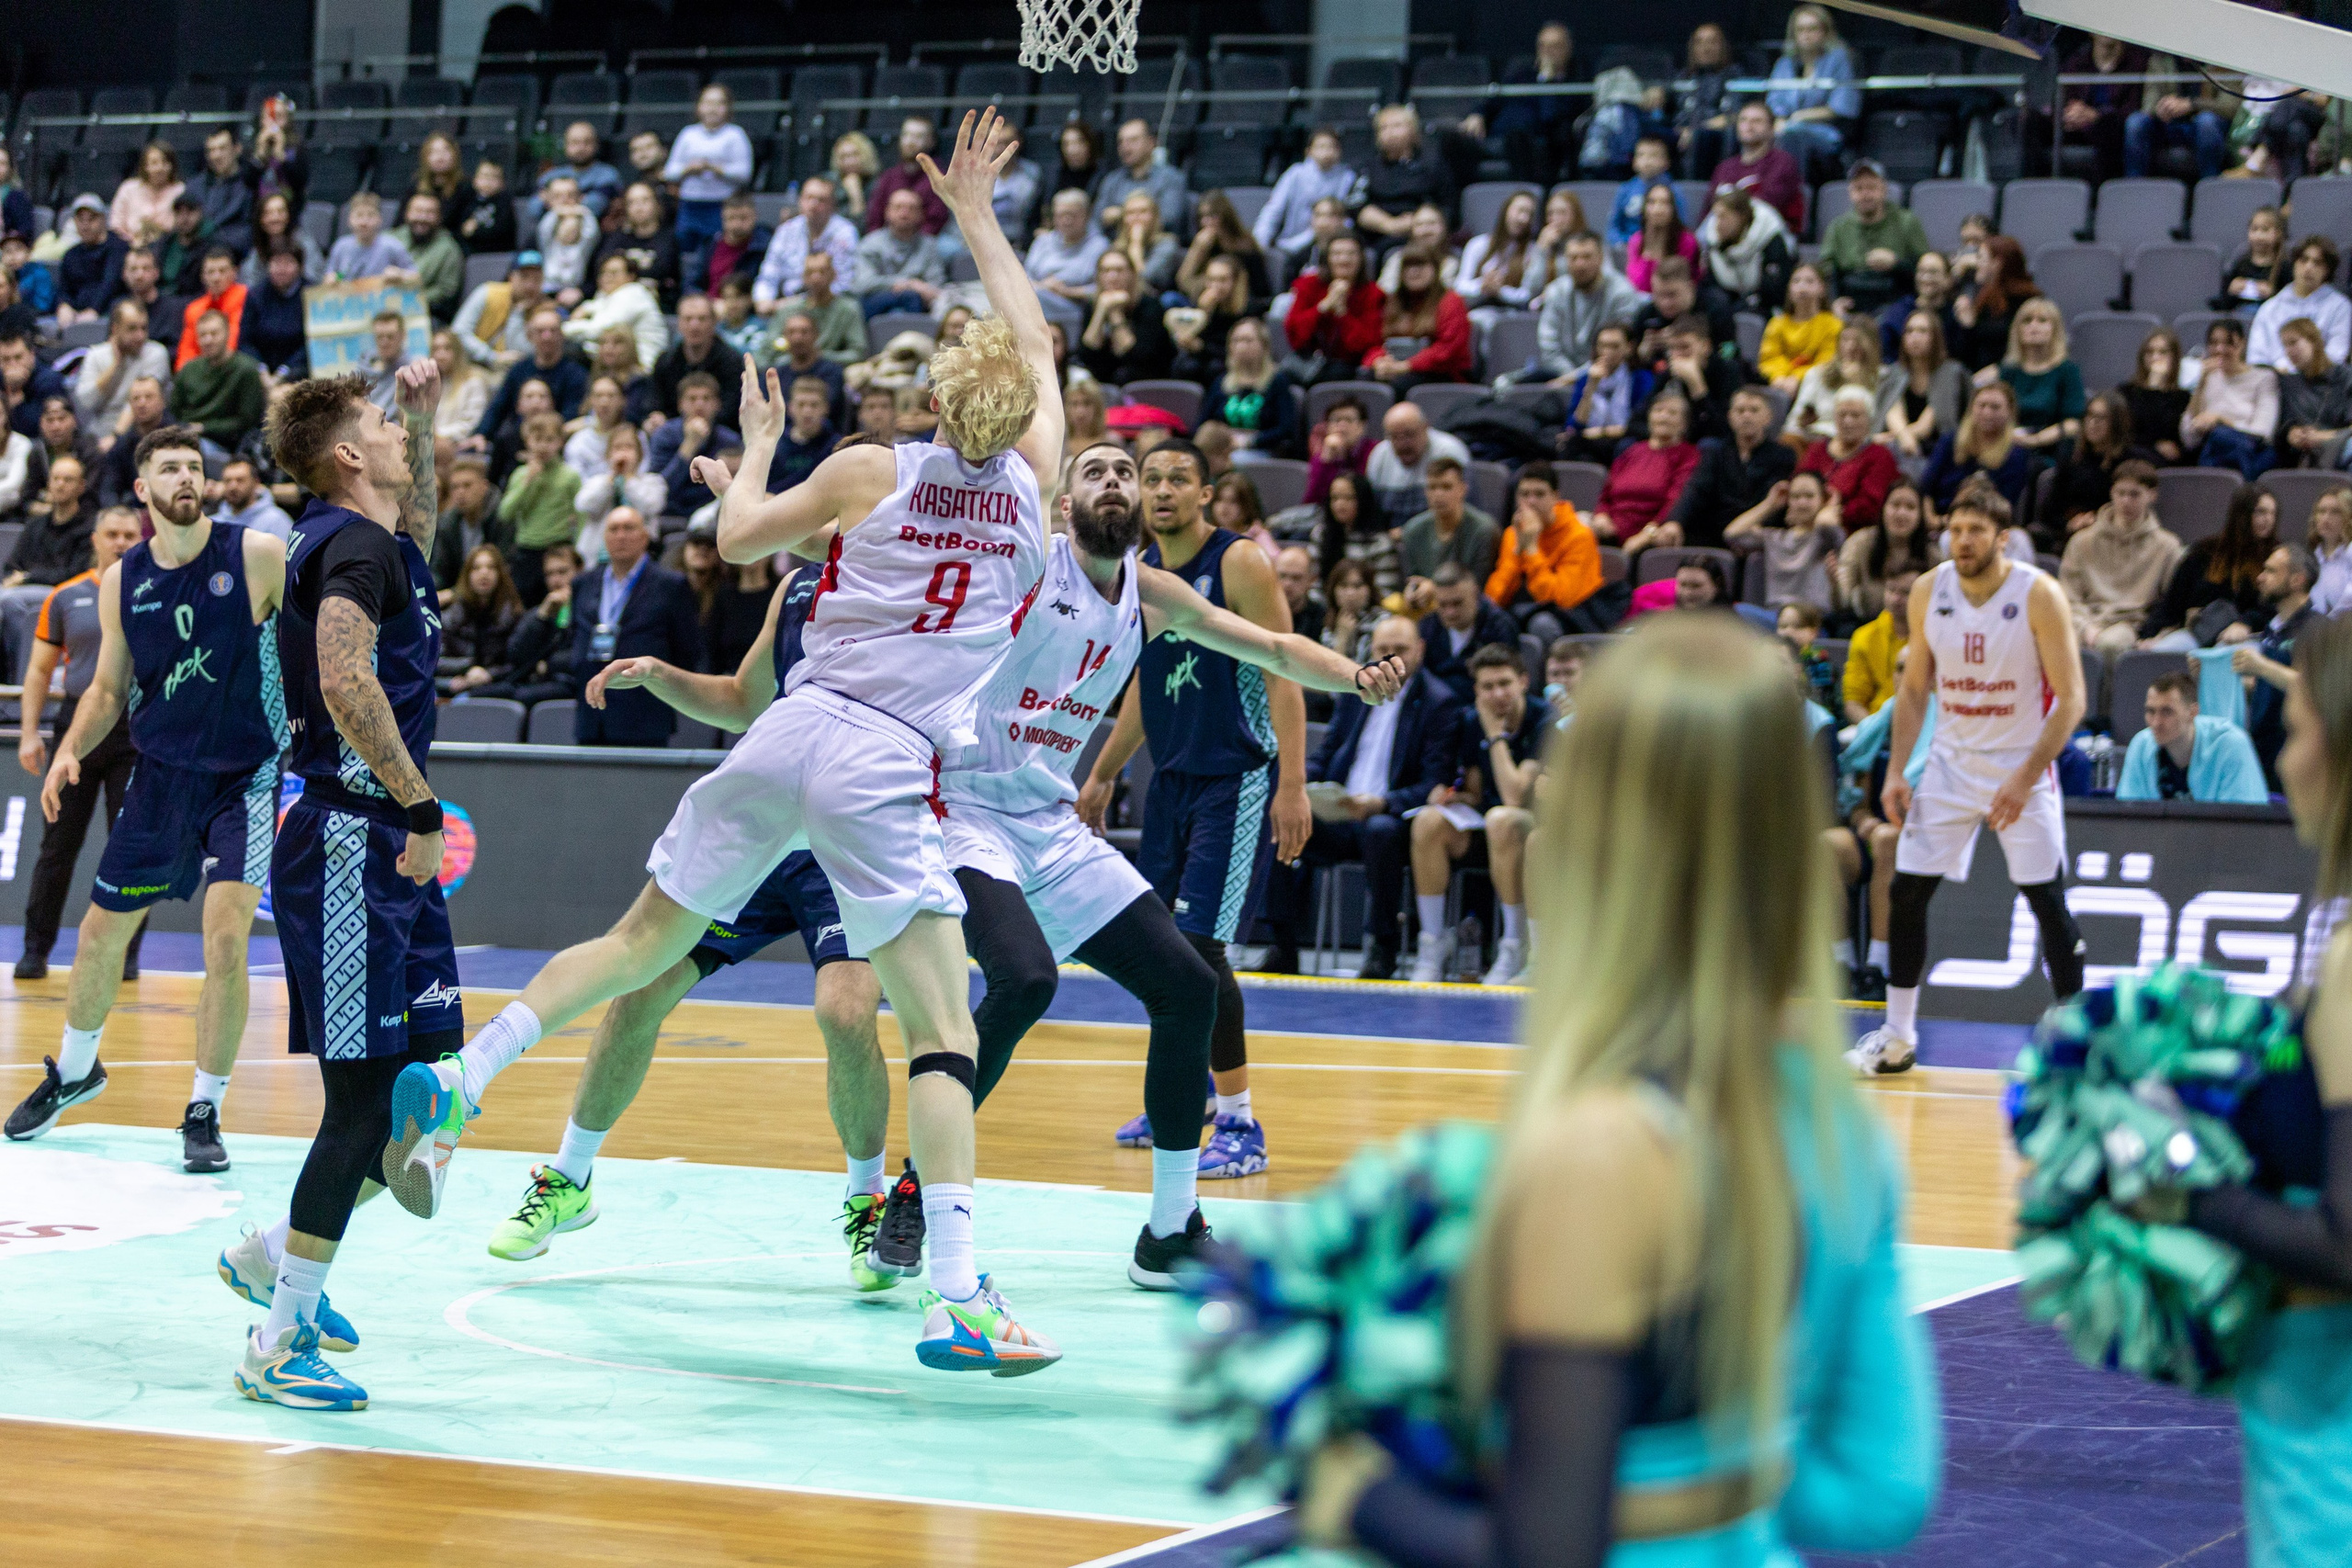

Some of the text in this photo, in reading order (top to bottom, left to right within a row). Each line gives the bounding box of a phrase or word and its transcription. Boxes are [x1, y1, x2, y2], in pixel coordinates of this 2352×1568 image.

[910, 481, 1019, 525] KASATKIN
[899, 525, 1016, 558] BetBoom
[911, 561, 972, 634] 9
[1963, 632, 1985, 664] 18
